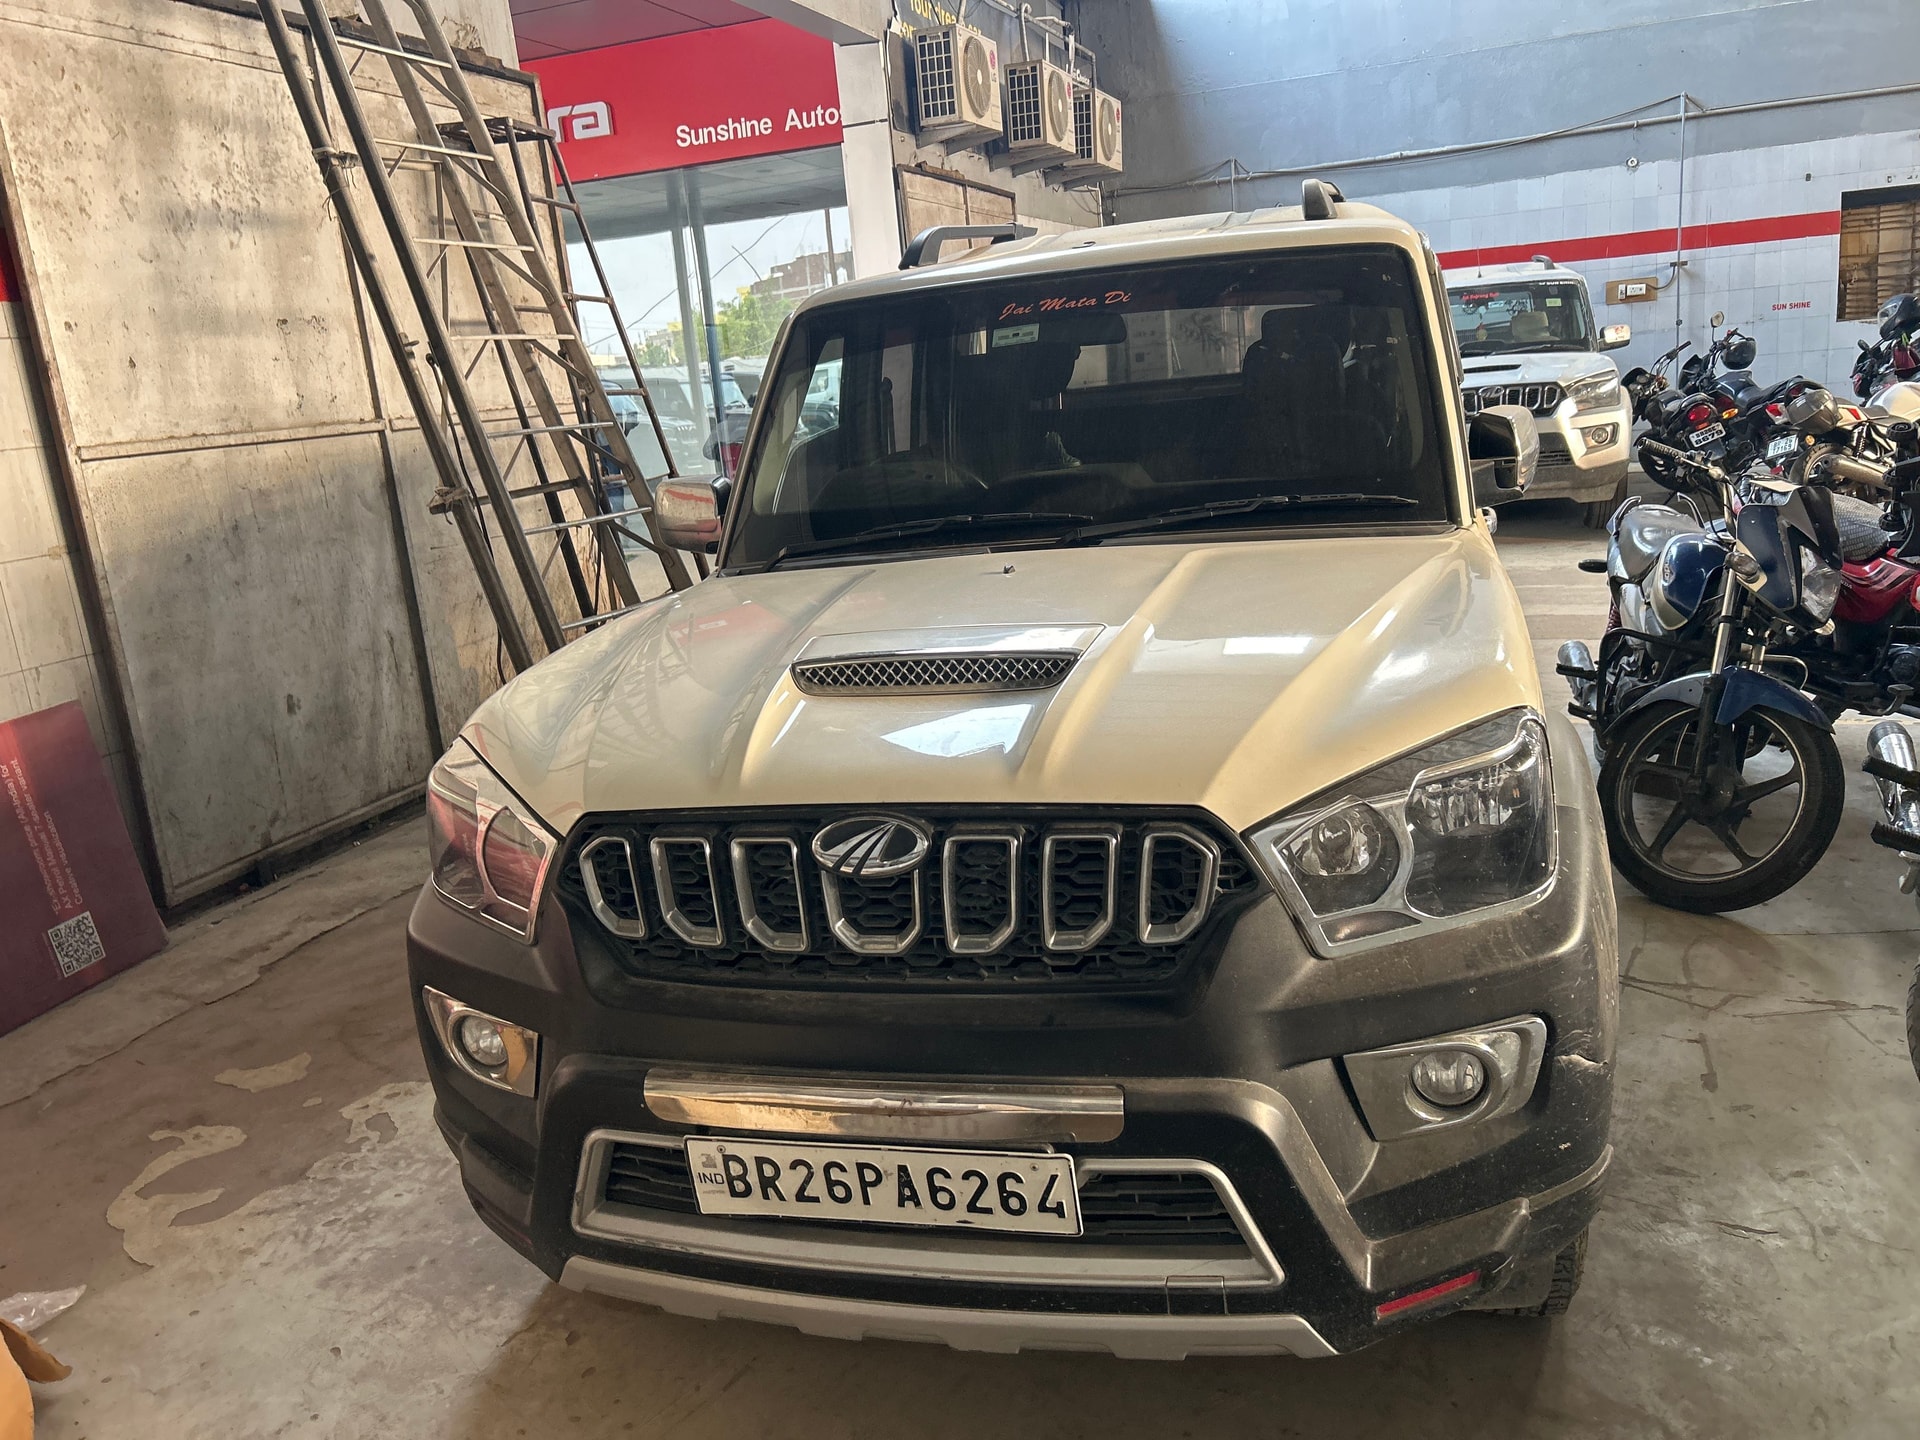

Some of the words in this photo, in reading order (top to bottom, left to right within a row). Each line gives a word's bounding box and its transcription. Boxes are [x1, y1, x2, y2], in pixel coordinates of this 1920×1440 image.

[676, 114, 773, 148] Sunshine
[784, 103, 844, 132] Auto
[999, 302, 1034, 321] Jai
[1039, 296, 1098, 312] Mata
[1104, 290, 1132, 305] Di
[1772, 303, 1787, 311] SUN
[1789, 301, 1811, 310] SHINE
[1694, 430, 1724, 446] 8679
[0, 763, 10, 777] for
[37, 831, 57, 865] Manual
[51, 866, 67, 893] Petrol
[63, 866, 84, 904] Creative
[61, 894, 73, 909] AX
[698, 1172, 725, 1185] IND
[722, 1152, 1068, 1219] BR26PA6264
